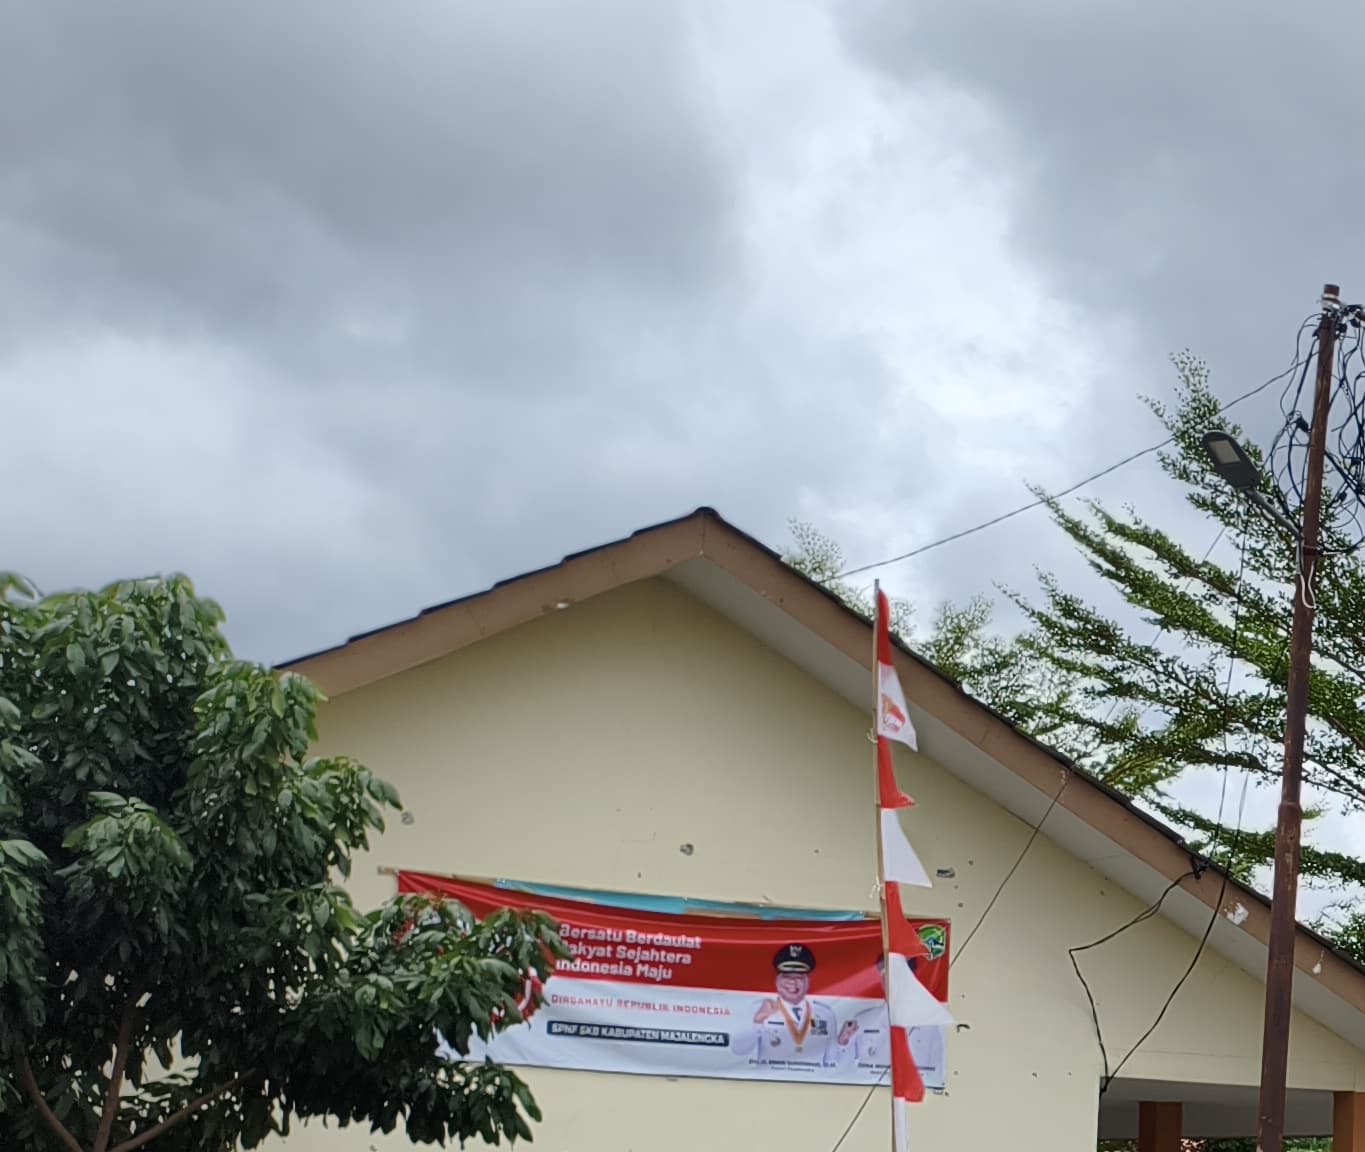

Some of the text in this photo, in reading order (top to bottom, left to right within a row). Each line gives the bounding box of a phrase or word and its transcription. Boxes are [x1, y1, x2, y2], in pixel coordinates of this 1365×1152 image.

[560, 924, 702, 949] Bersatu Berdaulat
[567, 941, 692, 965] akyat Sejahtera
[556, 958, 673, 982] Indonesia Maju
[616, 998, 670, 1012] REPUBLIK
[672, 1004, 731, 1016] INDONESIA
[601, 1026, 660, 1041] KABUPATEN
[661, 1030, 725, 1044] MAJALENGKA
